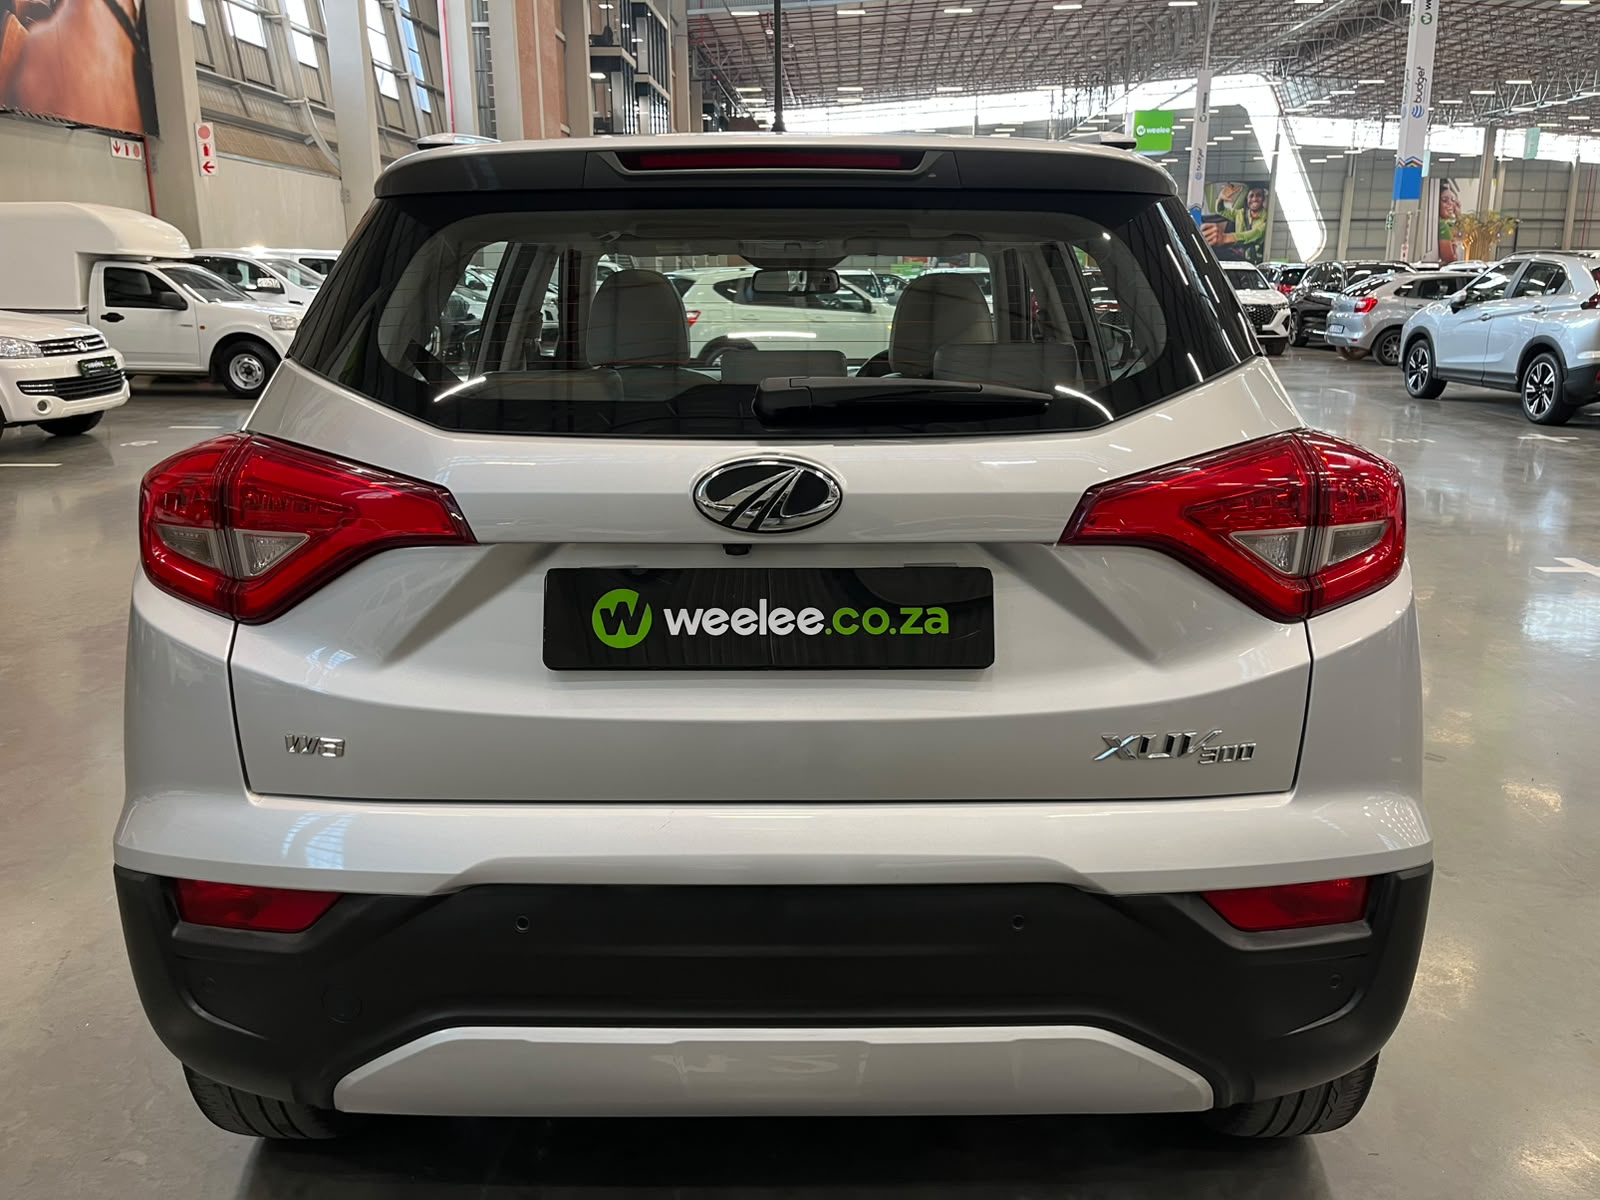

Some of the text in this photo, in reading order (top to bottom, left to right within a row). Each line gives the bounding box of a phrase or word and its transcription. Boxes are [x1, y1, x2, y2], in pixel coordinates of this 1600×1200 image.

[1413, 66, 1427, 103] budget
[1147, 126, 1171, 134] weelee
[663, 598, 950, 636] weelee.co.za
